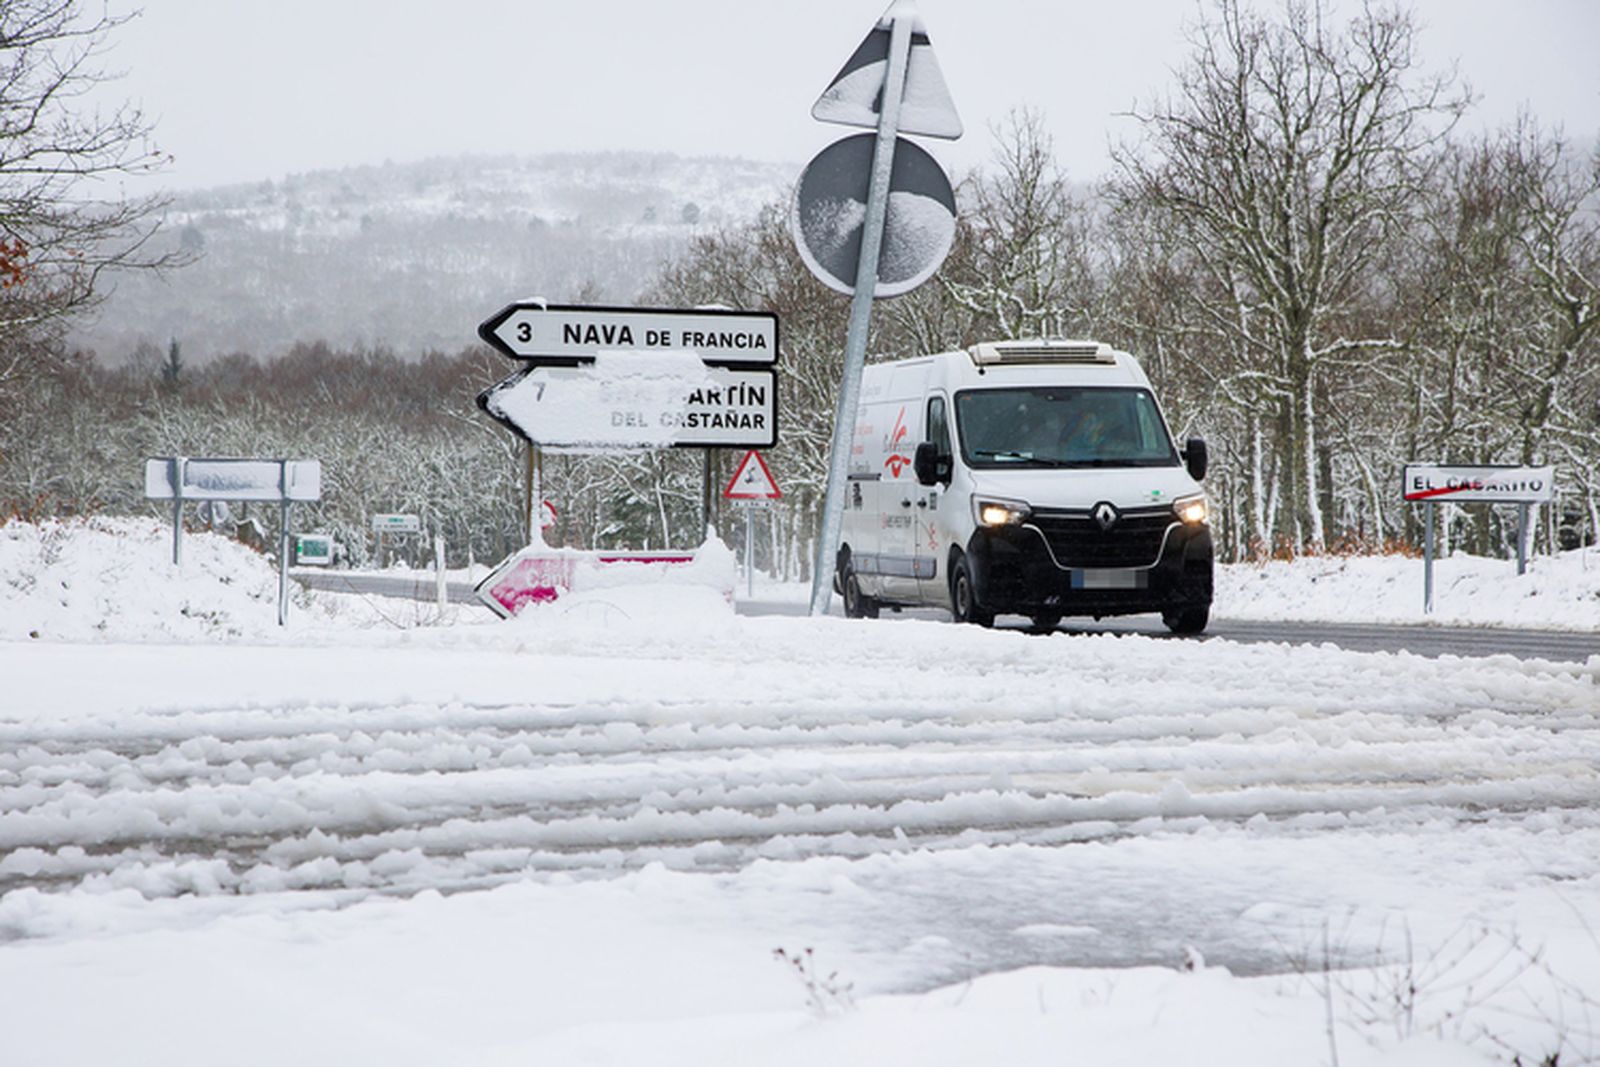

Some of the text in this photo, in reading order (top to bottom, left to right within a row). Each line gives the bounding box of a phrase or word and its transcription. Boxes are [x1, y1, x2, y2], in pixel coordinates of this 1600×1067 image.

[517, 322, 767, 350] 3 NAVA DE FRANCIA
[671, 381, 766, 407] ARTÍN
[659, 409, 765, 430] CASTAÑAR
[1413, 476, 1436, 491] EL
